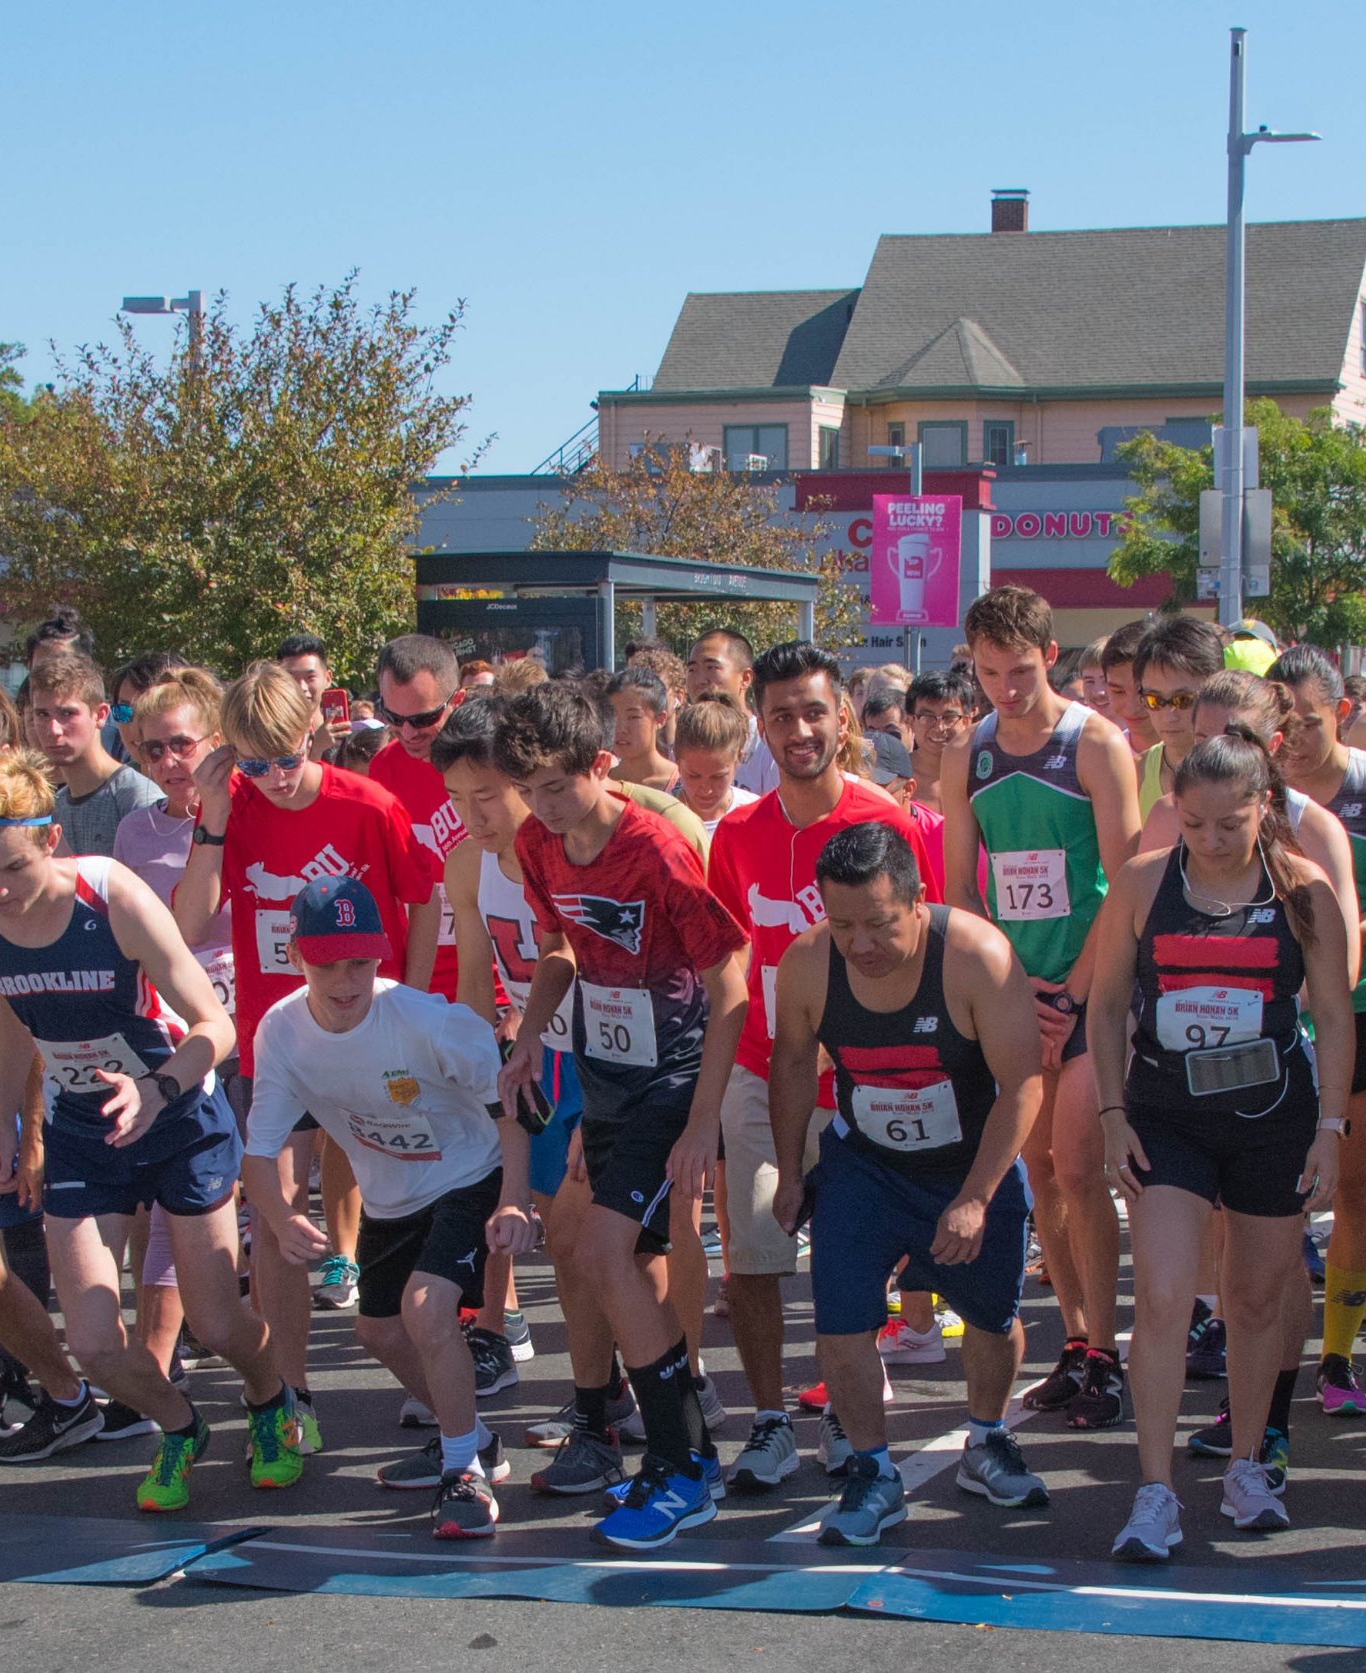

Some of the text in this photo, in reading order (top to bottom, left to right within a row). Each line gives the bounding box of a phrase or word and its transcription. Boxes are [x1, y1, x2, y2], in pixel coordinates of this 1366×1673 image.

[887, 502, 946, 515] PEELING
[889, 515, 943, 527] LUCKY?
[871, 636, 894, 647] Hair
[430, 799, 462, 845] BU
[1040, 865, 1048, 874] 5K
[1006, 883, 1054, 910] 173
[622, 1004, 633, 1016] 5K
[1175, 1003, 1239, 1016] BRIAN HONAN 5K
[599, 1021, 631, 1053] 50
[1185, 1024, 1231, 1050] 97
[62, 1060, 131, 1086] 222
[870, 1102, 934, 1112] BRIAN HONAN 5K
[885, 1118, 930, 1142] 61
